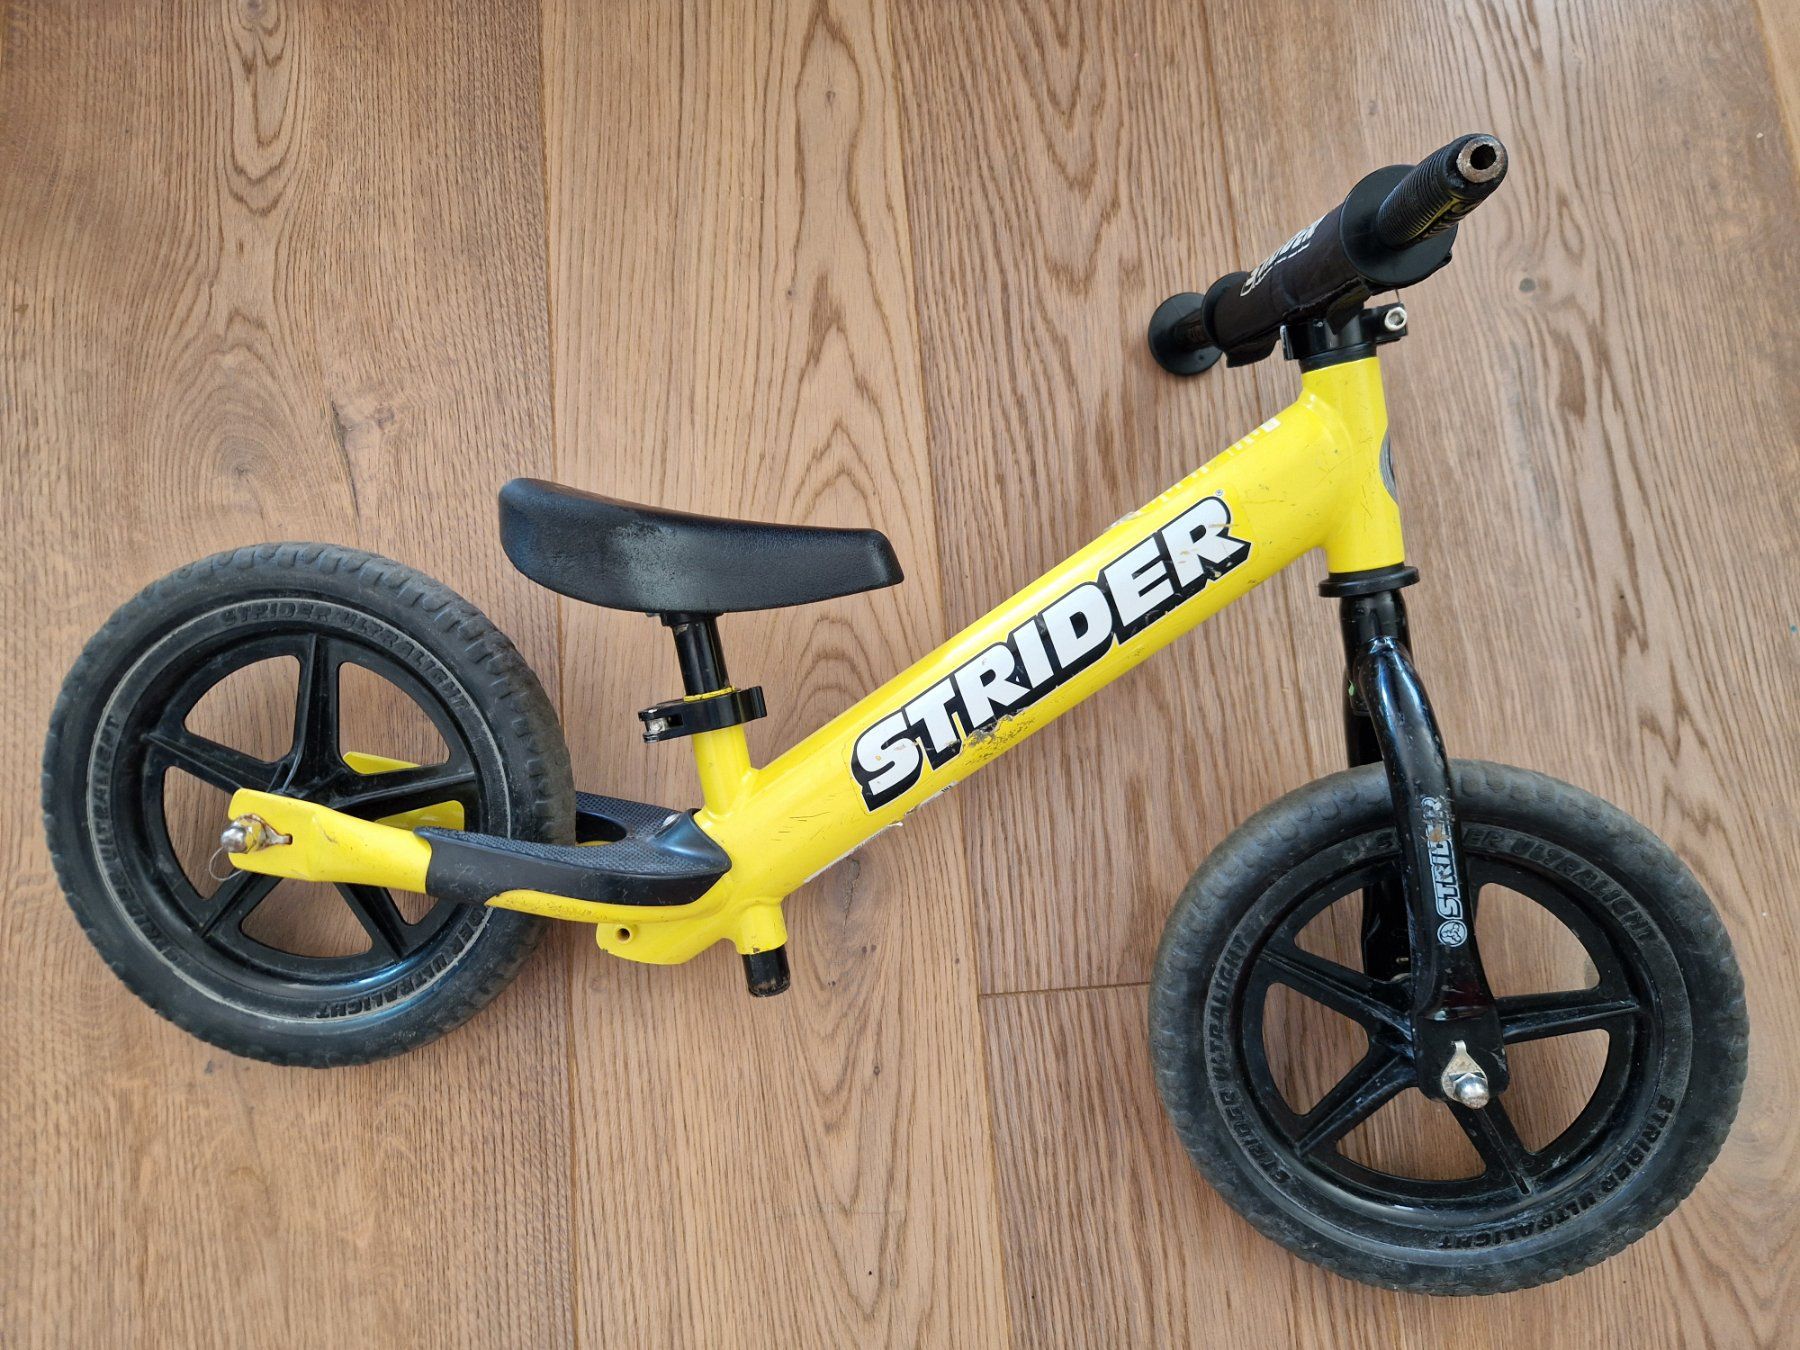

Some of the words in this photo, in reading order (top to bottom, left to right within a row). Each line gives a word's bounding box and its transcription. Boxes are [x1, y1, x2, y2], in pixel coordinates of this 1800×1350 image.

[222, 601, 332, 627] STRIDER
[851, 495, 1251, 811] STRIDER
[315, 952, 449, 1019] ULTRALIGHT
[1208, 932, 1248, 1082] ULTRALIGHT
[1219, 1088, 1291, 1184] STRIDER
[1600, 1094, 1675, 1192] STRIDER
[1438, 1190, 1597, 1249] ULTRALIGHT
